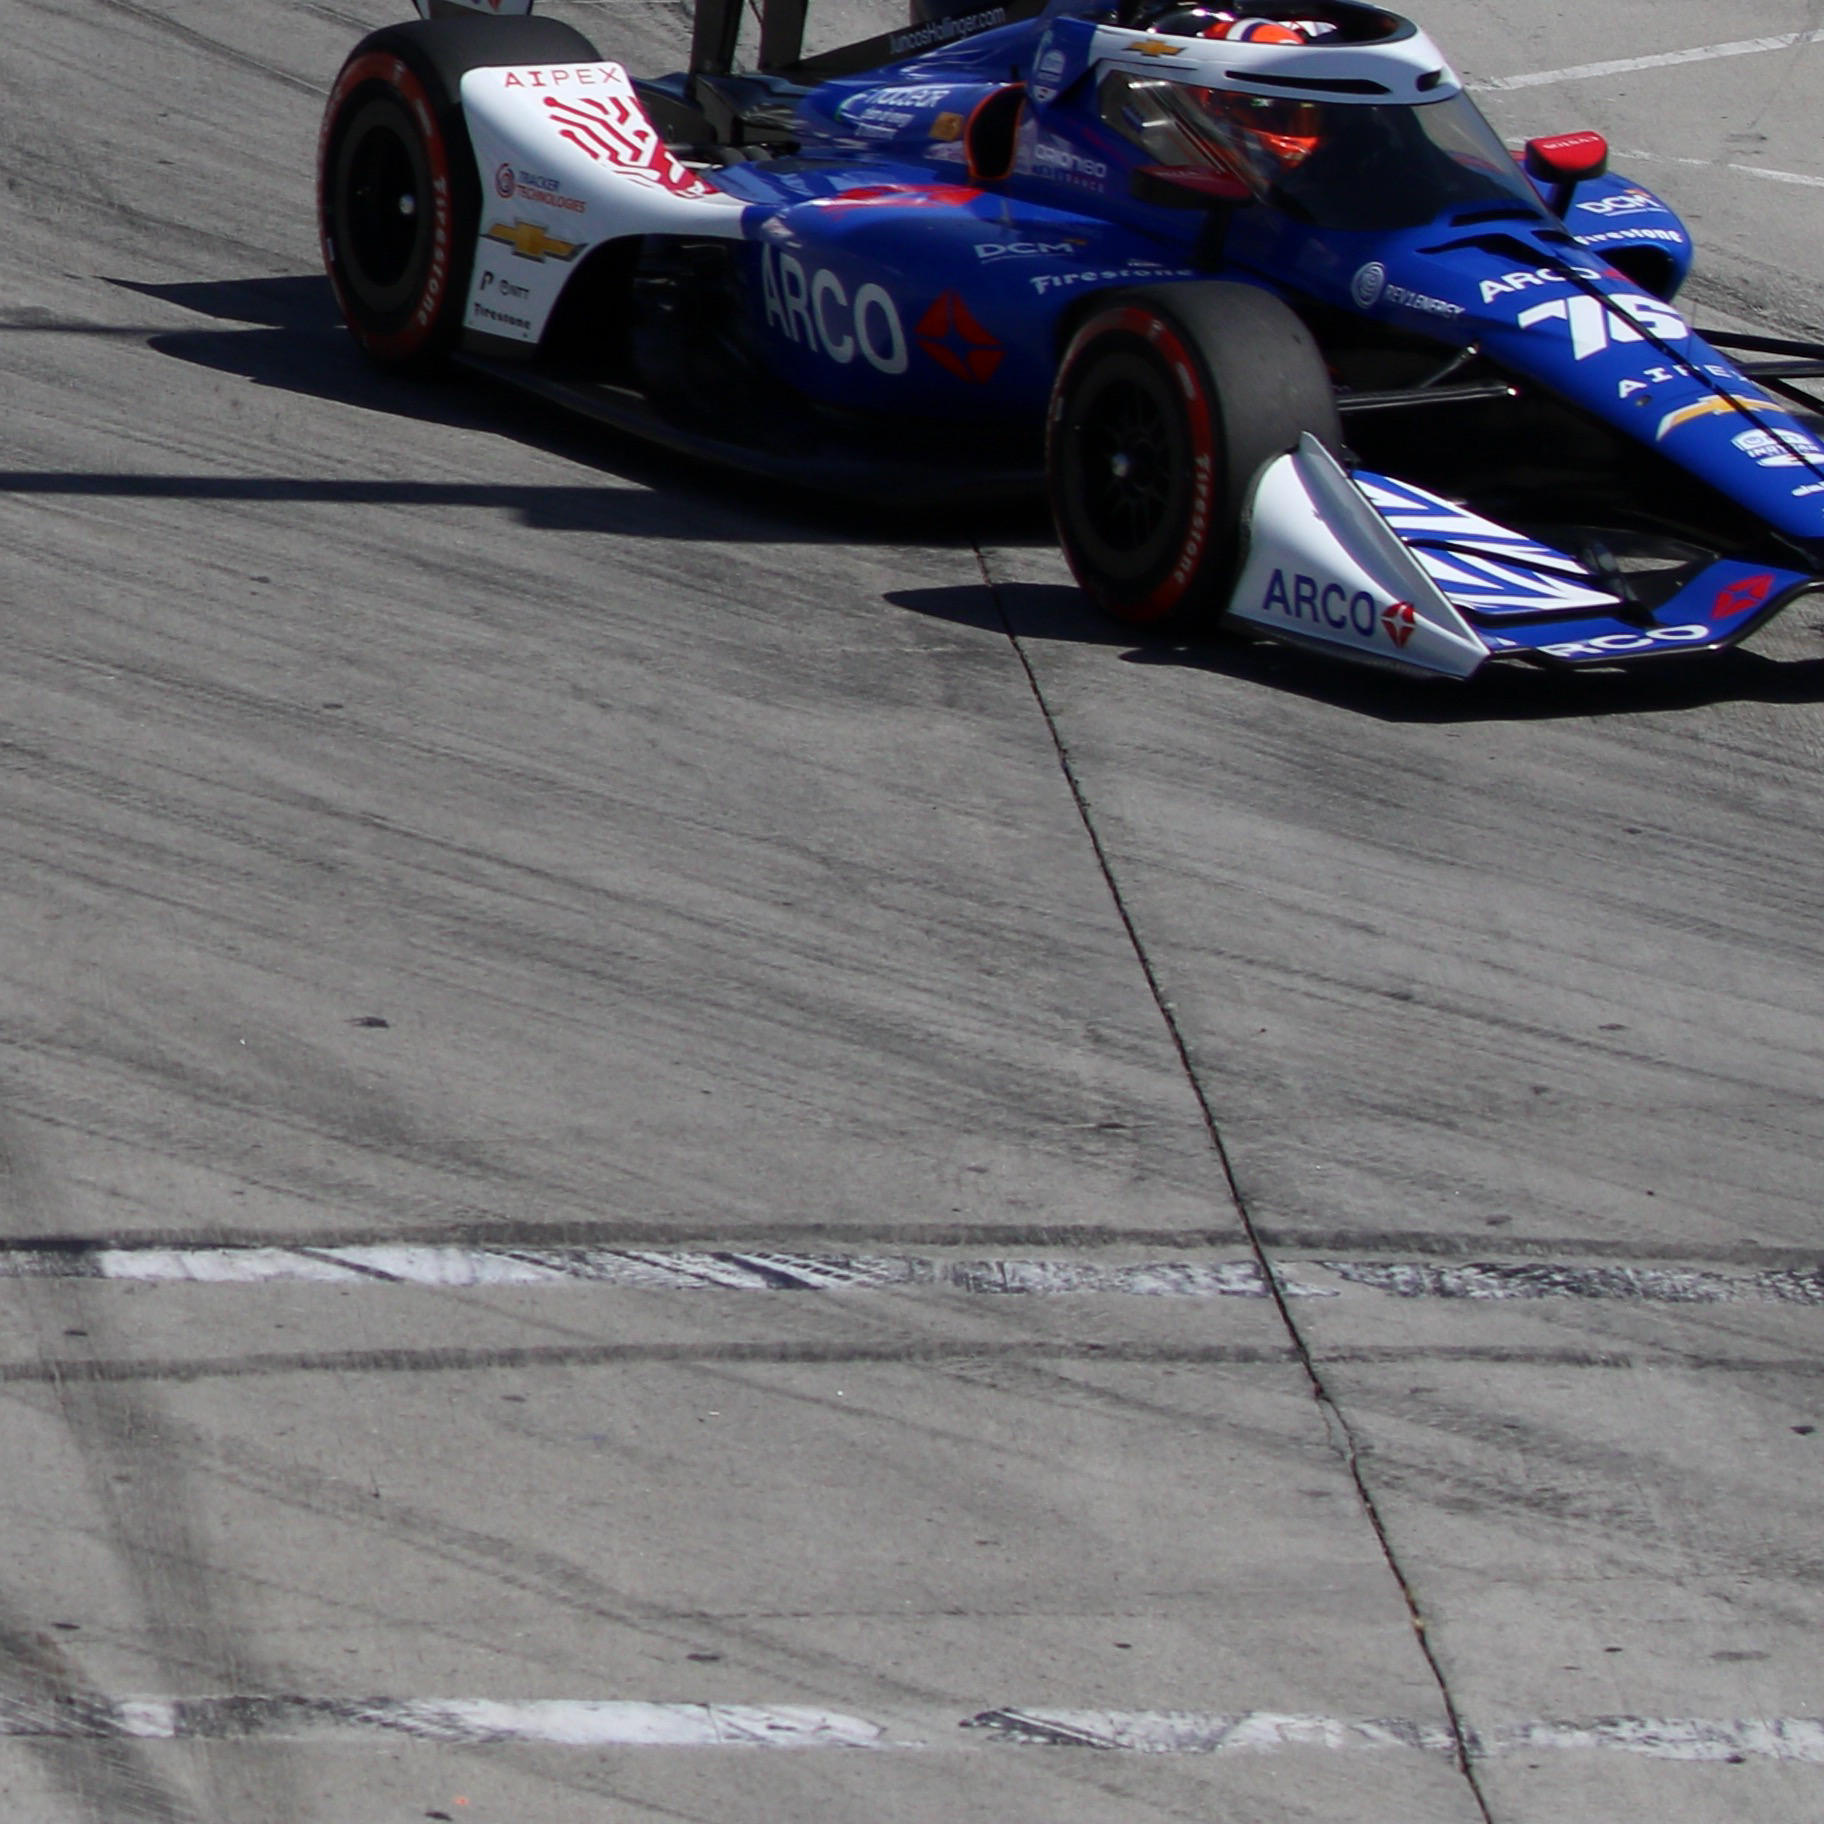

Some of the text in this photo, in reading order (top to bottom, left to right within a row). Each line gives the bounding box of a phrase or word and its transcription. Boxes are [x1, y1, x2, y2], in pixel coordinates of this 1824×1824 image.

[504, 67, 624, 89] AIPEX
[1575, 194, 1663, 215] DCM
[1572, 228, 1684, 246] Firestone
[973, 241, 1074, 258] DCM
[1029, 269, 1194, 295] Firestone
[761, 241, 909, 375] ARCO
[1262, 568, 1377, 638] ARCO
